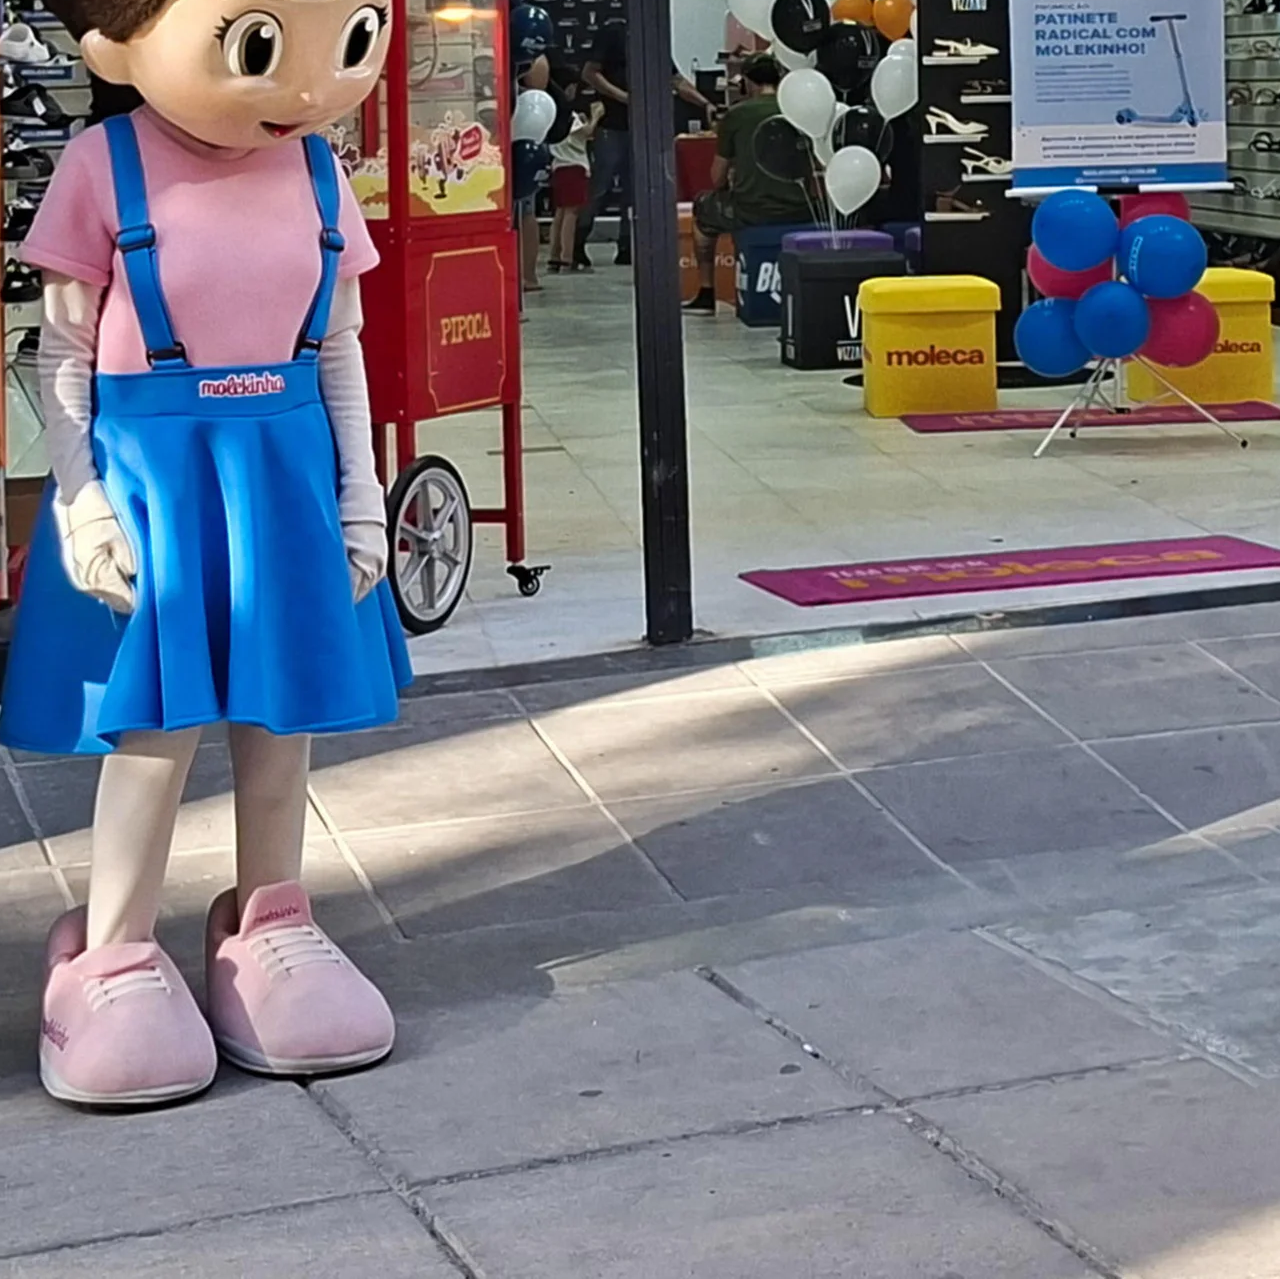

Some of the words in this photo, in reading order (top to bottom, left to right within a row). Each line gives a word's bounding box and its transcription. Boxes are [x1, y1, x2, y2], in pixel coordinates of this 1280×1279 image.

[1034, 12, 1118, 25] PATINETE
[1035, 28, 1113, 41] RADICAL
[1115, 27, 1156, 39] COM
[1035, 43, 1146, 57] MOLEKINHO!
[440, 310, 492, 346] PIPOCA
[1211, 339, 1262, 354] oleca
[886, 344, 985, 366] moleca
